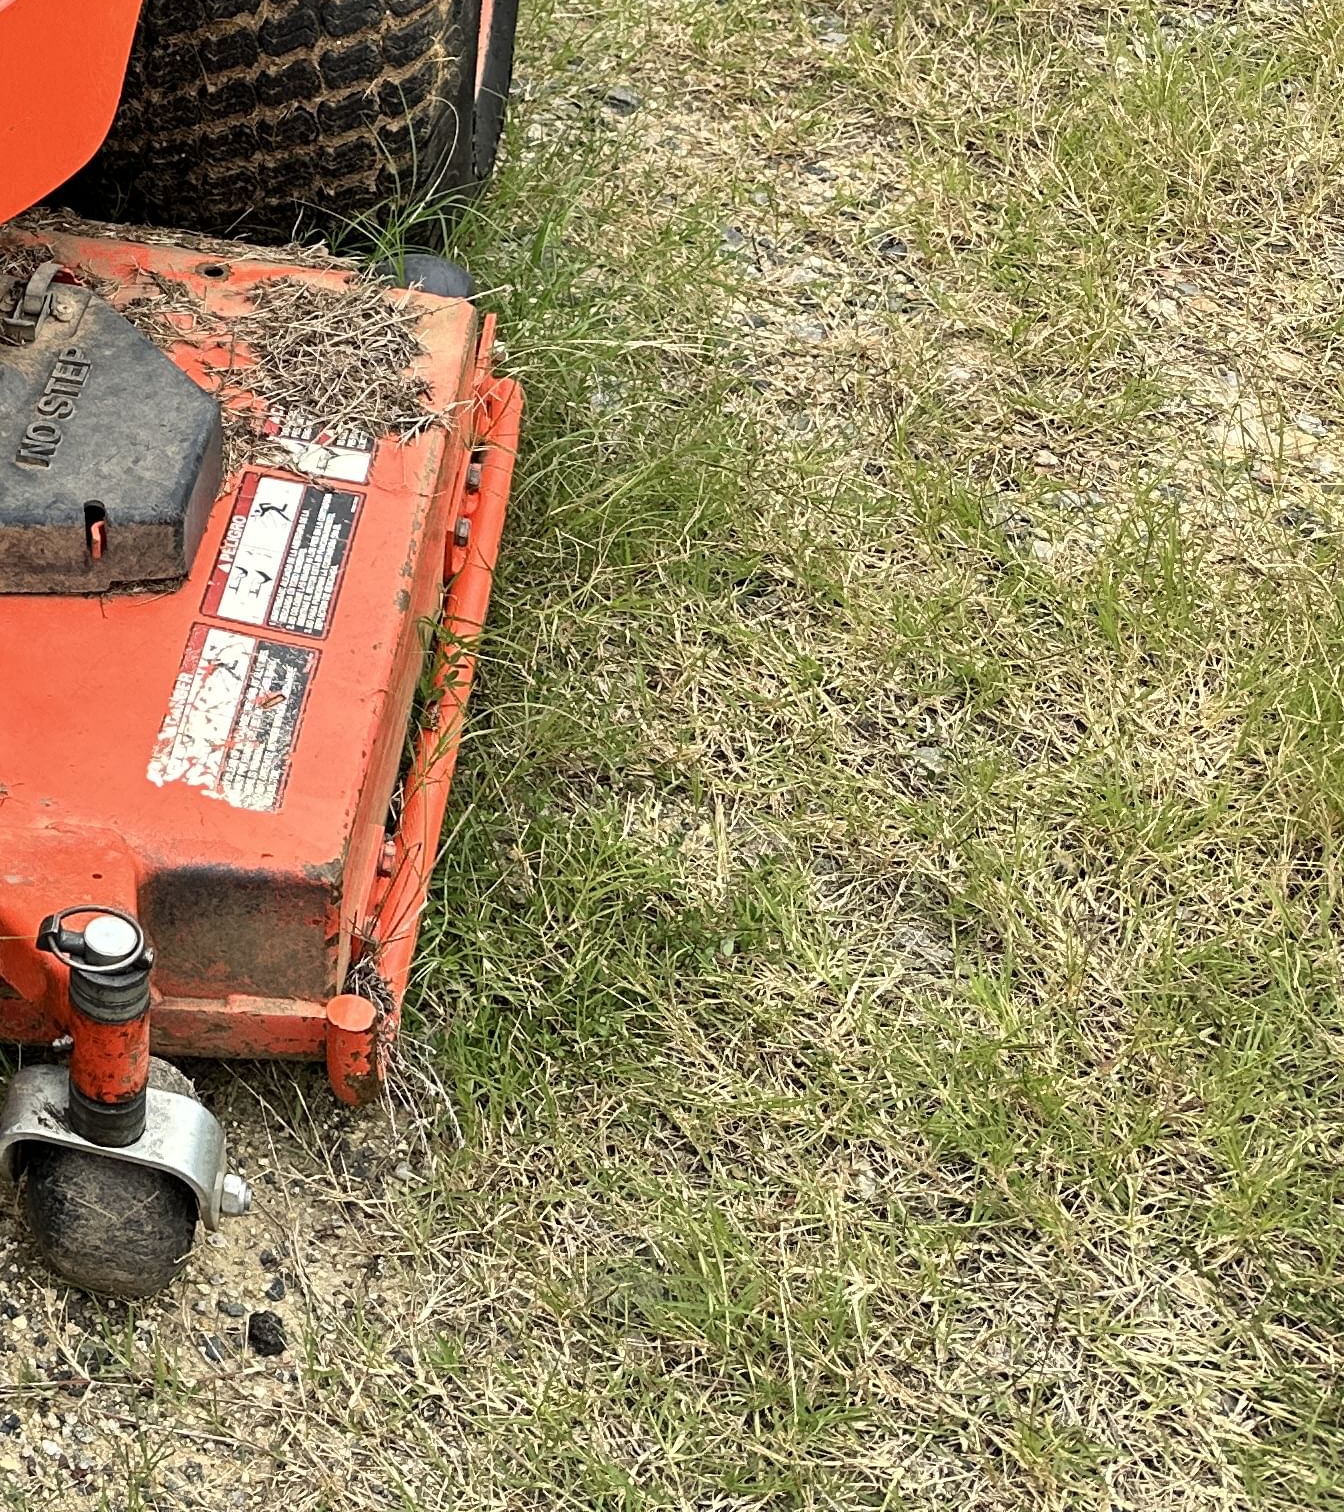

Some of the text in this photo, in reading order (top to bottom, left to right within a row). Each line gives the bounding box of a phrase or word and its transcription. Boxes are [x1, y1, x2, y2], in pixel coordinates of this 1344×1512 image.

[15, 347, 93, 469] NO STEP
[219, 515, 246, 564] PELIGRO
